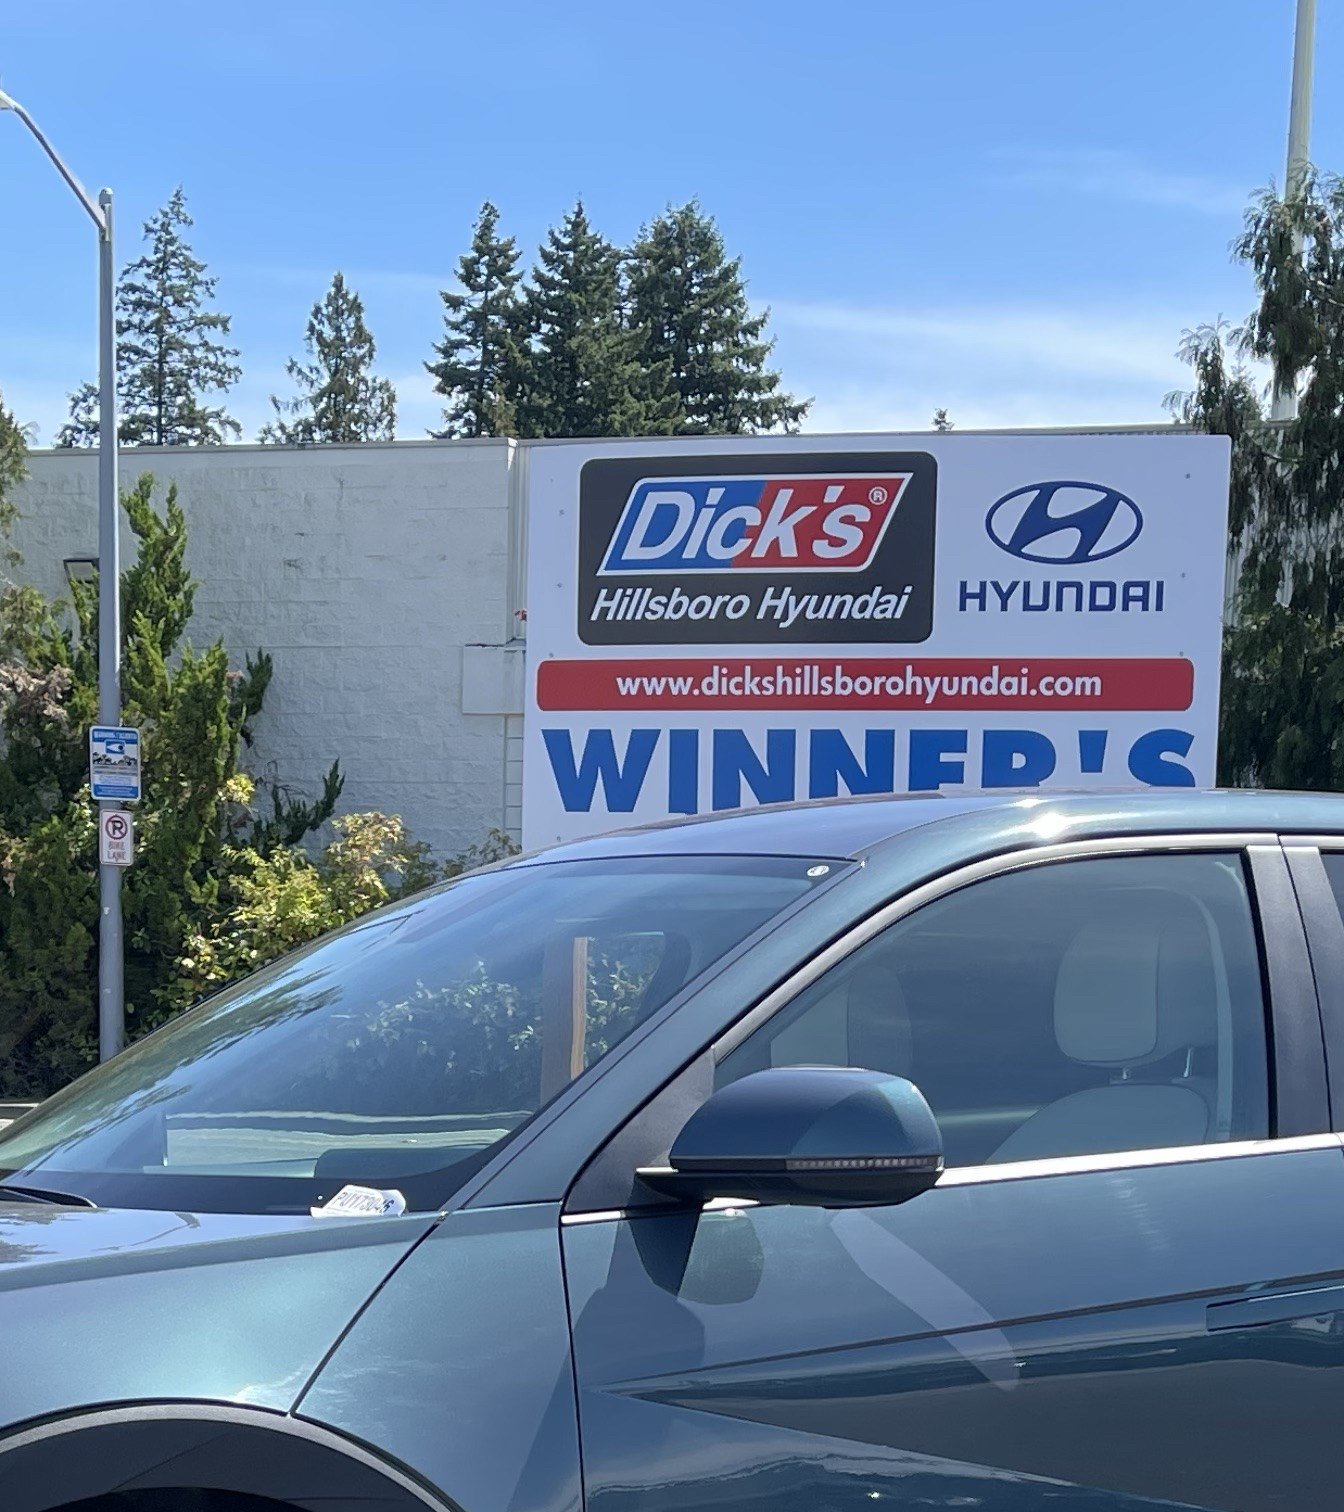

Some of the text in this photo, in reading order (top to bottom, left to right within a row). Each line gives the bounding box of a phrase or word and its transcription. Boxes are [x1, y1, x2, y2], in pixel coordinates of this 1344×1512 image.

[590, 584, 913, 628] Hillsboro Hyundai
[959, 580, 1164, 613] HYUNDAI
[615, 664, 1103, 705] www.dickshillsborohyundai.com
